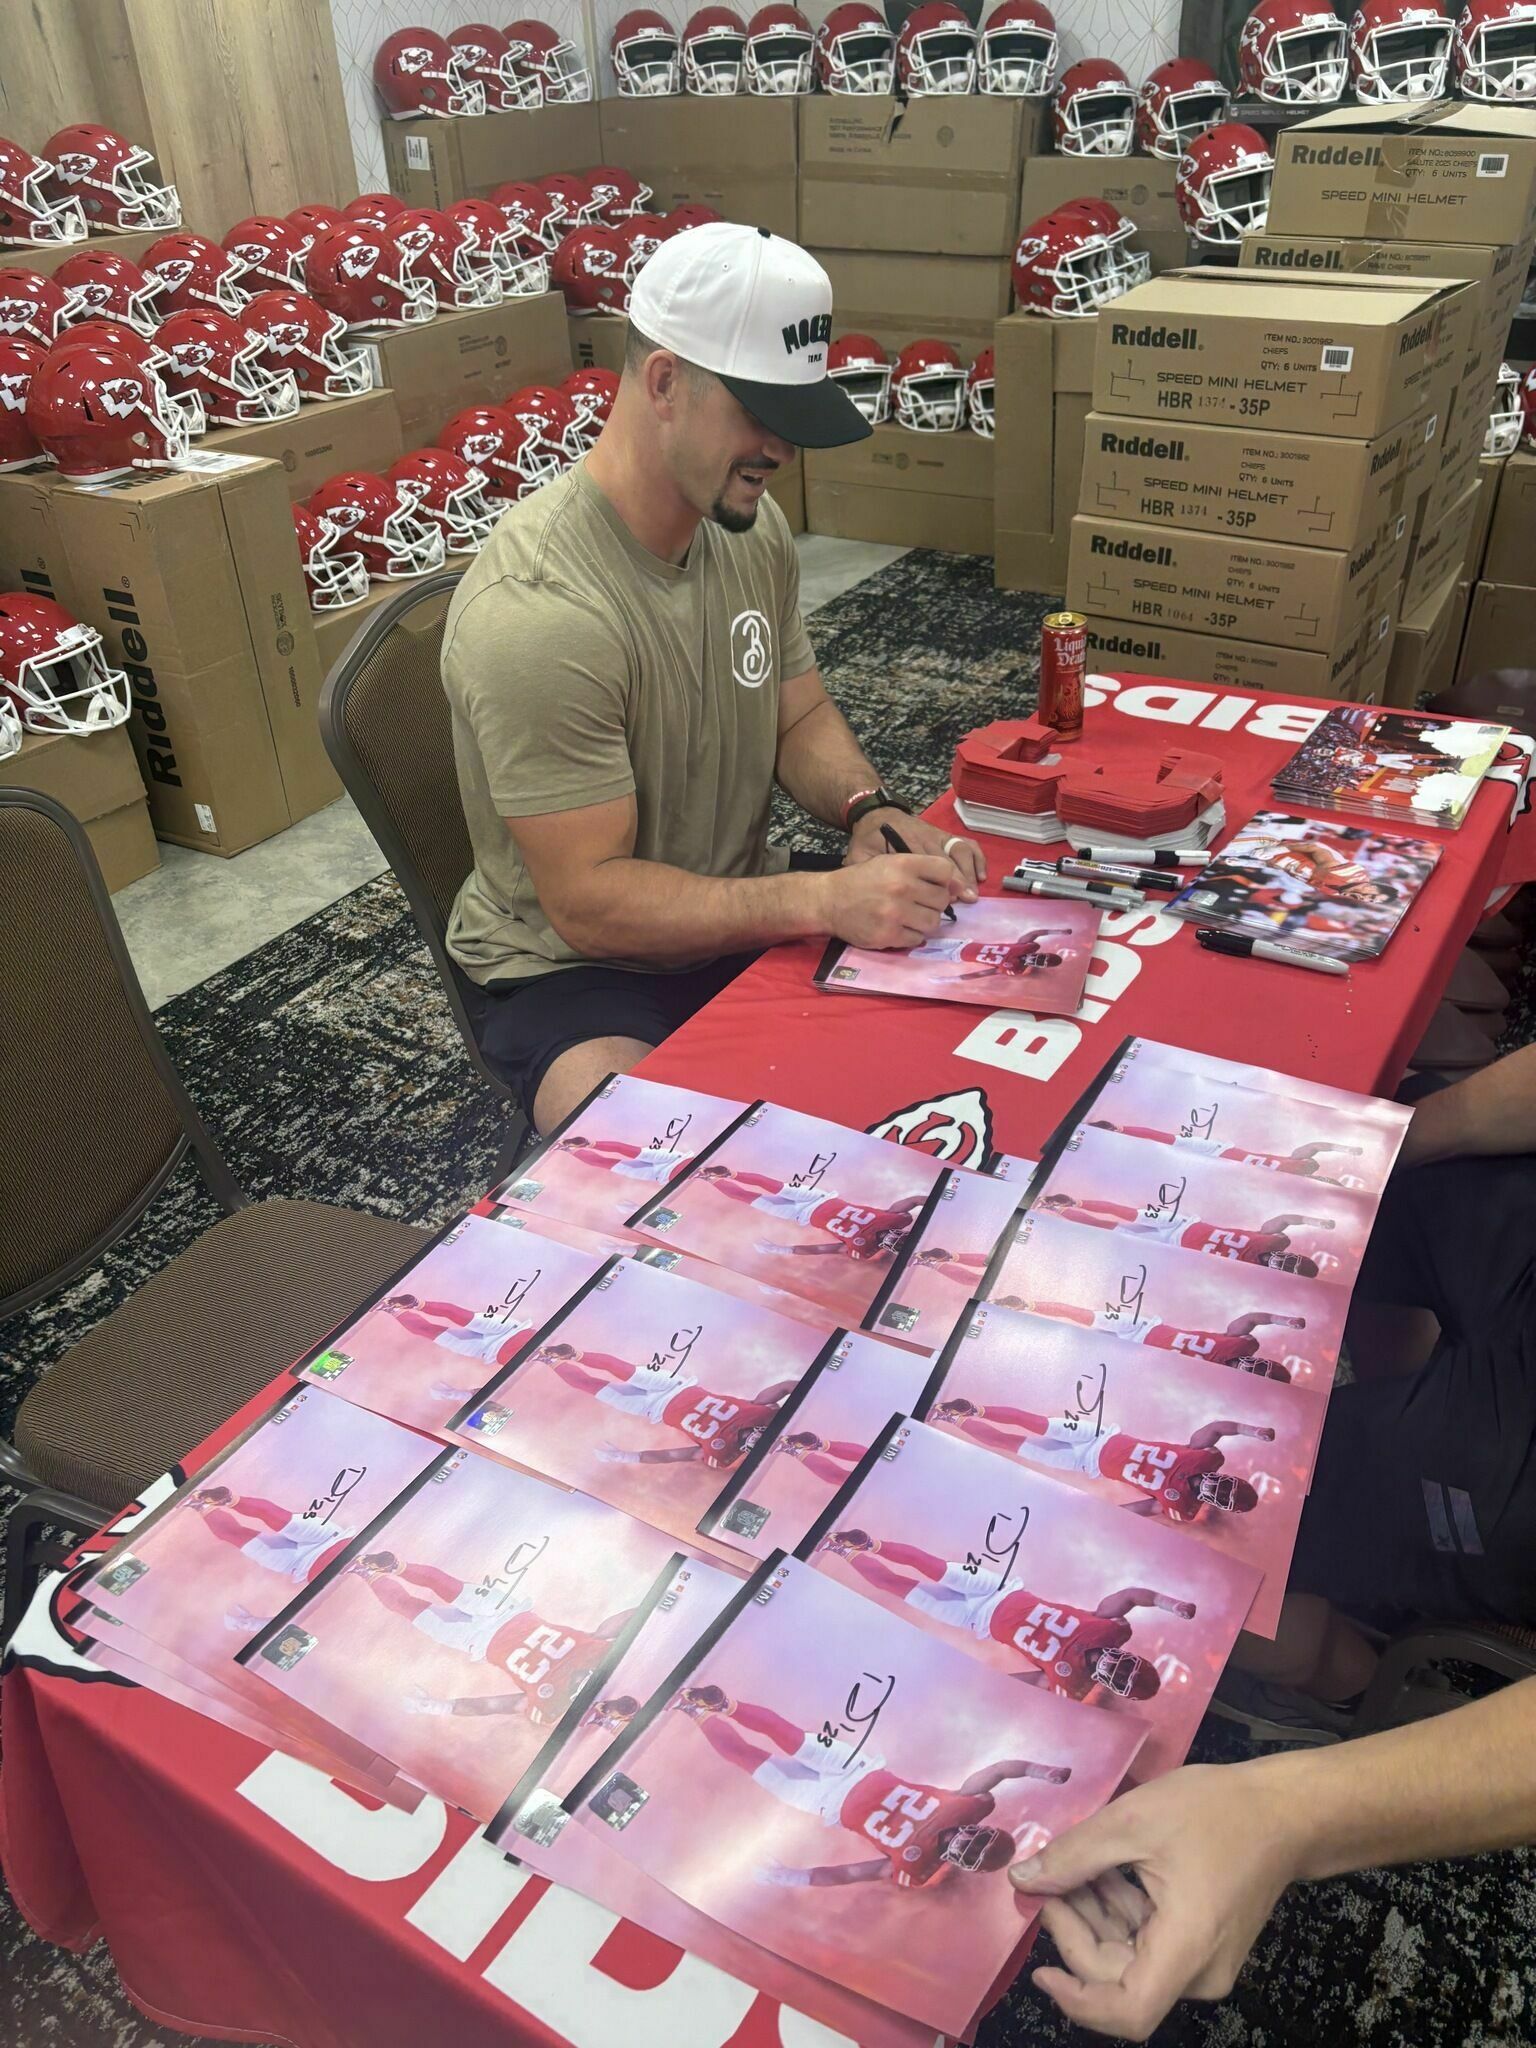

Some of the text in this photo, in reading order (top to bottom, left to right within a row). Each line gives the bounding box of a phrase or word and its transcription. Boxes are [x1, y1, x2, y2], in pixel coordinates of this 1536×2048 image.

[1291, 145, 1380, 166] Riddell
[1442, 170, 1467, 178] UNITS
[1321, 190, 1467, 205] SPEED MINI HELMET
[1255, 247, 1340, 269] Riddell
[1112, 325, 1197, 349] Riddell
[1264, 333, 1283, 342] ITEM
[1262, 347, 1288, 355] CHIEFS
[1261, 361, 1317, 372] QTY: 6 UNITS
[1157, 372, 1308, 393] SPEED MINI HELMET
[1158, 391, 1192, 409] HBR
[1101, 433, 1183, 461] Riddell
[1243, 448, 1261, 457] ITEM
[1144, 477, 1288, 504] SPEED MINI HELMET
[1239, 473, 1258, 482] QTY:
[1271, 478, 1294, 487] UNITS
[1141, 498, 1174, 517] HBR
[1091, 535, 1172, 566] Riddell
[1133, 578, 1275, 610] SPEED MINI HELMET
[1258, 583, 1280, 594] UNITS
[1133, 600, 1162, 616] HBR
[1086, 632, 1160, 660] Riddell
[103, 586, 183, 788] Riddell
[826, 1205, 877, 1237] 23
[680, 1395, 740, 1439] 23
[1122, 1443, 1178, 1492] 23
[1012, 1602, 1080, 1663] 23
[506, 1624, 577, 1685] 23
[864, 1784, 941, 1849] 23
